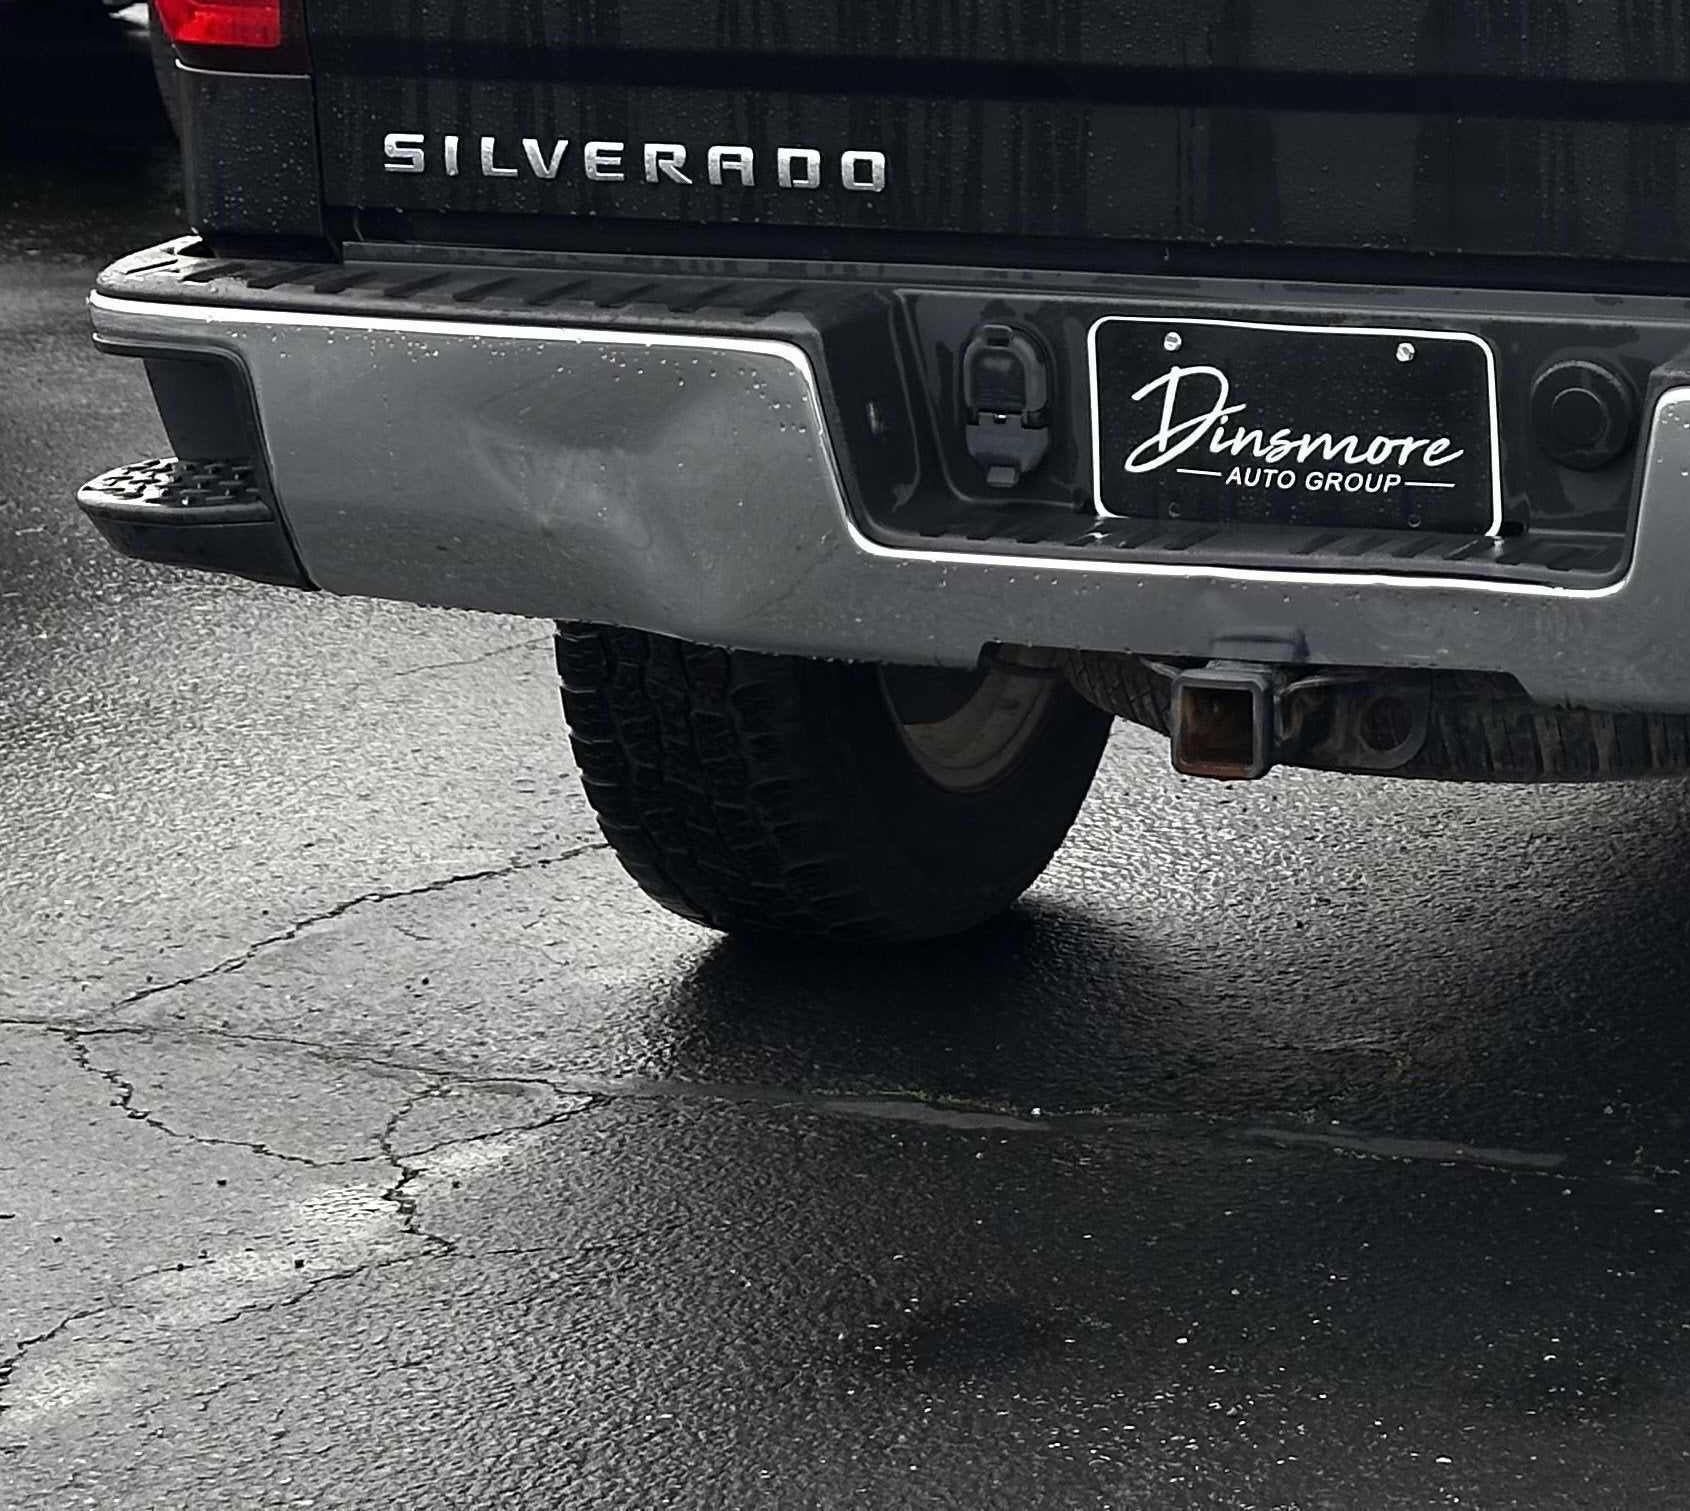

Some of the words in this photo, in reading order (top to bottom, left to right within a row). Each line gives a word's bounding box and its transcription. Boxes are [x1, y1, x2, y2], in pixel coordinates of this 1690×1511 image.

[383, 133, 886, 192] SILVERADO
[1124, 365, 1464, 473] Dinsmore
[1225, 466, 1297, 490] AUTO
[1304, 470, 1402, 494] GROUP
